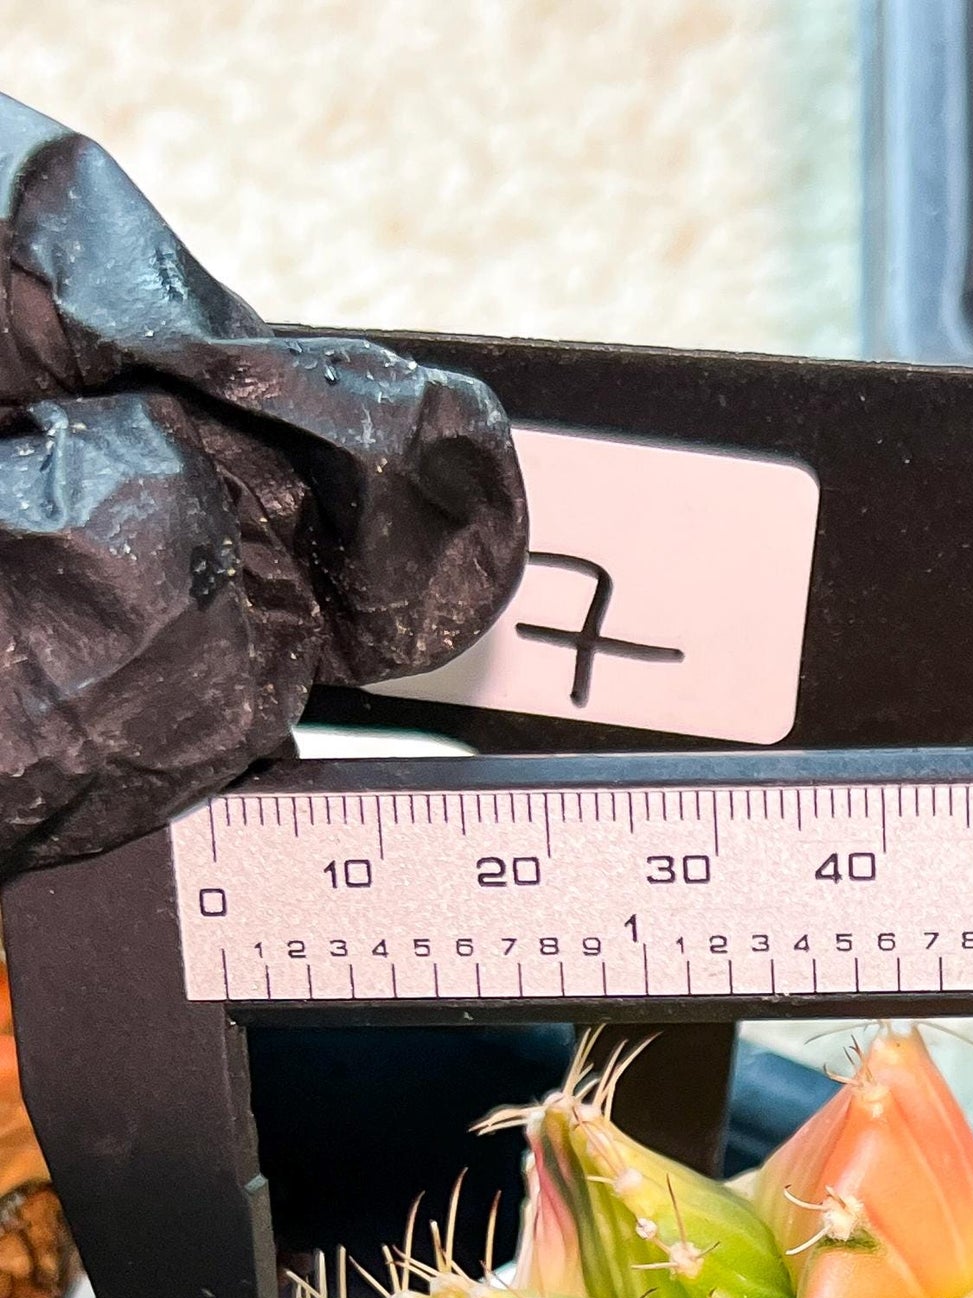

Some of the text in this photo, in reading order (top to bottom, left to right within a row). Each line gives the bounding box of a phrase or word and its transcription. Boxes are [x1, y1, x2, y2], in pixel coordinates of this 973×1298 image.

[199, 888, 227, 917] 0
[324, 859, 372, 888] 10
[477, 857, 540, 887] 20
[647, 855, 710, 884] 30
[815, 853, 876, 884] 40
[253, 941, 264, 959] 1
[286, 939, 307, 959] 2
[329, 939, 349, 957] 3
[371, 938, 390, 959] 4
[412, 938, 431, 958] 5
[455, 938, 474, 957] 6
[501, 937, 518, 956] 7
[539, 937, 560, 956] 8
[582, 936, 602, 957] 9
[623, 913, 638, 943] 1
[675, 936, 685, 954] 1
[708, 934, 728, 954] 2
[751, 934, 770, 953] 3
[793, 934, 810, 953] 4
[835, 933, 853, 952] 5
[877, 932, 896, 952] 6
[923, 931, 940, 950] 7
